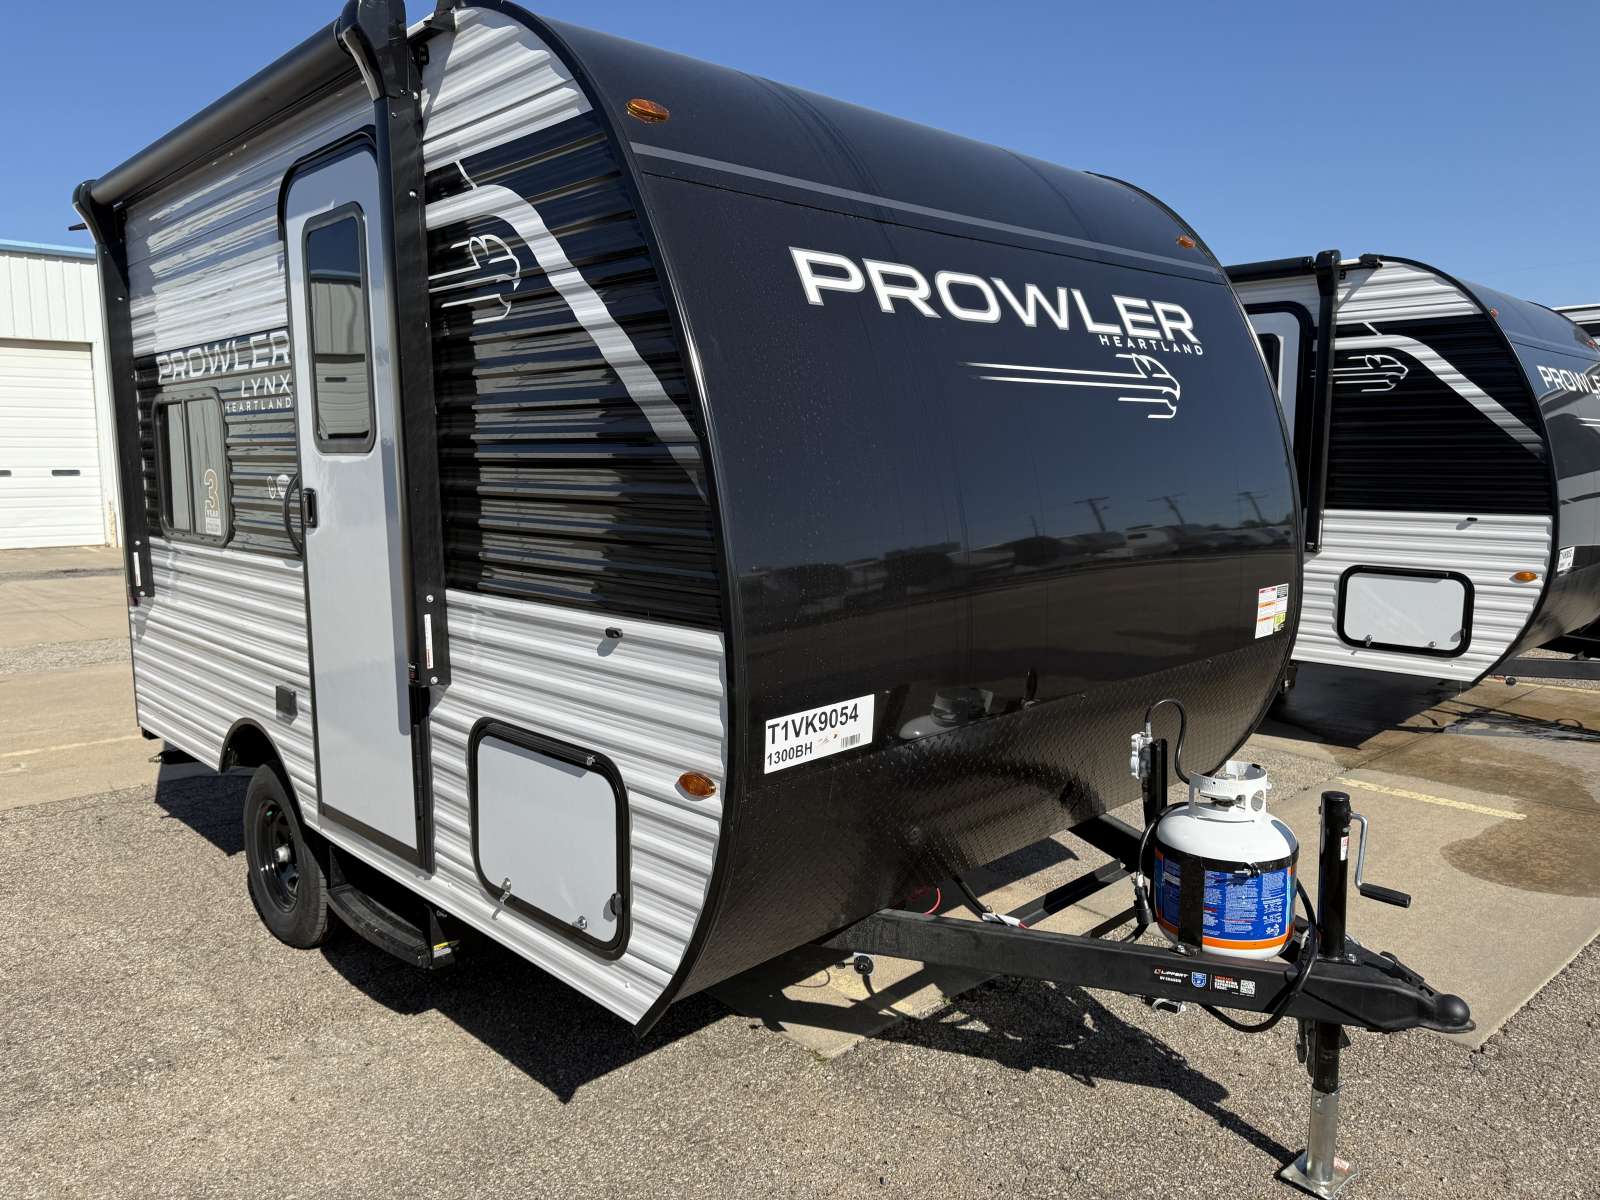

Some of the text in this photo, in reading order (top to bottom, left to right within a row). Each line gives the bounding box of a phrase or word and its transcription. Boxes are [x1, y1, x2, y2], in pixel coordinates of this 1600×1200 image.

[789, 246, 1202, 345] PROWLER
[155, 330, 291, 385] PROWLER
[1099, 334, 1204, 356] HEARTLAND
[240, 373, 291, 398] LYNX
[224, 397, 293, 413] HEARTLAND
[767, 702, 859, 745] T1VK9054
[766, 741, 813, 766] 1300BH
